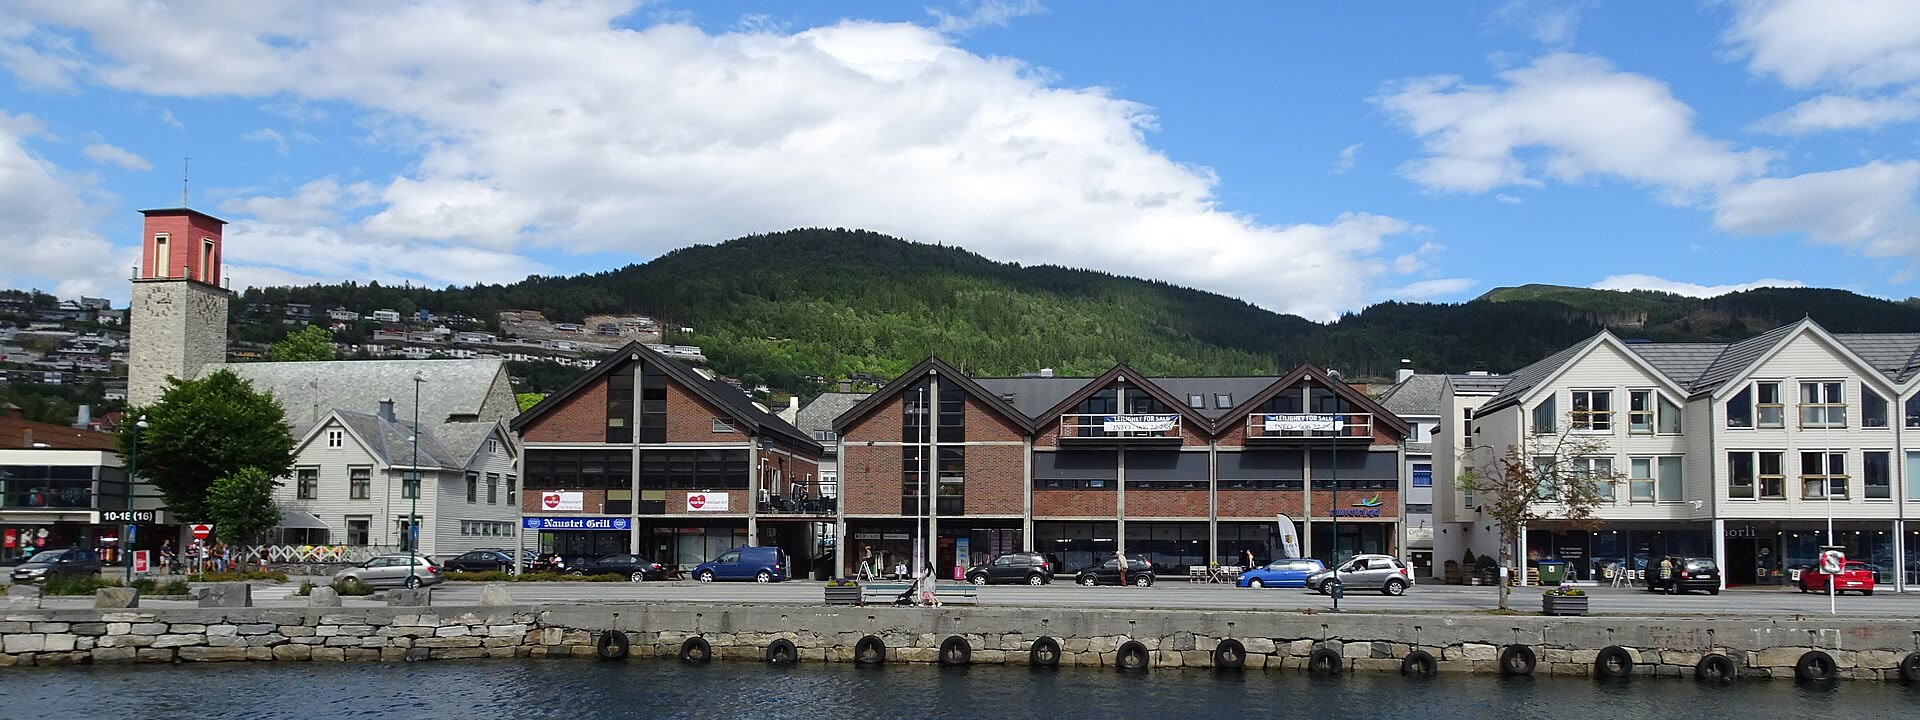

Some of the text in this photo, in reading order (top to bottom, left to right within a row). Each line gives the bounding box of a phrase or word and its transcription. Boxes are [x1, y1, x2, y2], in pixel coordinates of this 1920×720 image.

[103, 511, 153, 521] 10-18 (16)
[544, 518, 583, 528] Naustet
[586, 519, 610, 528] Grill
